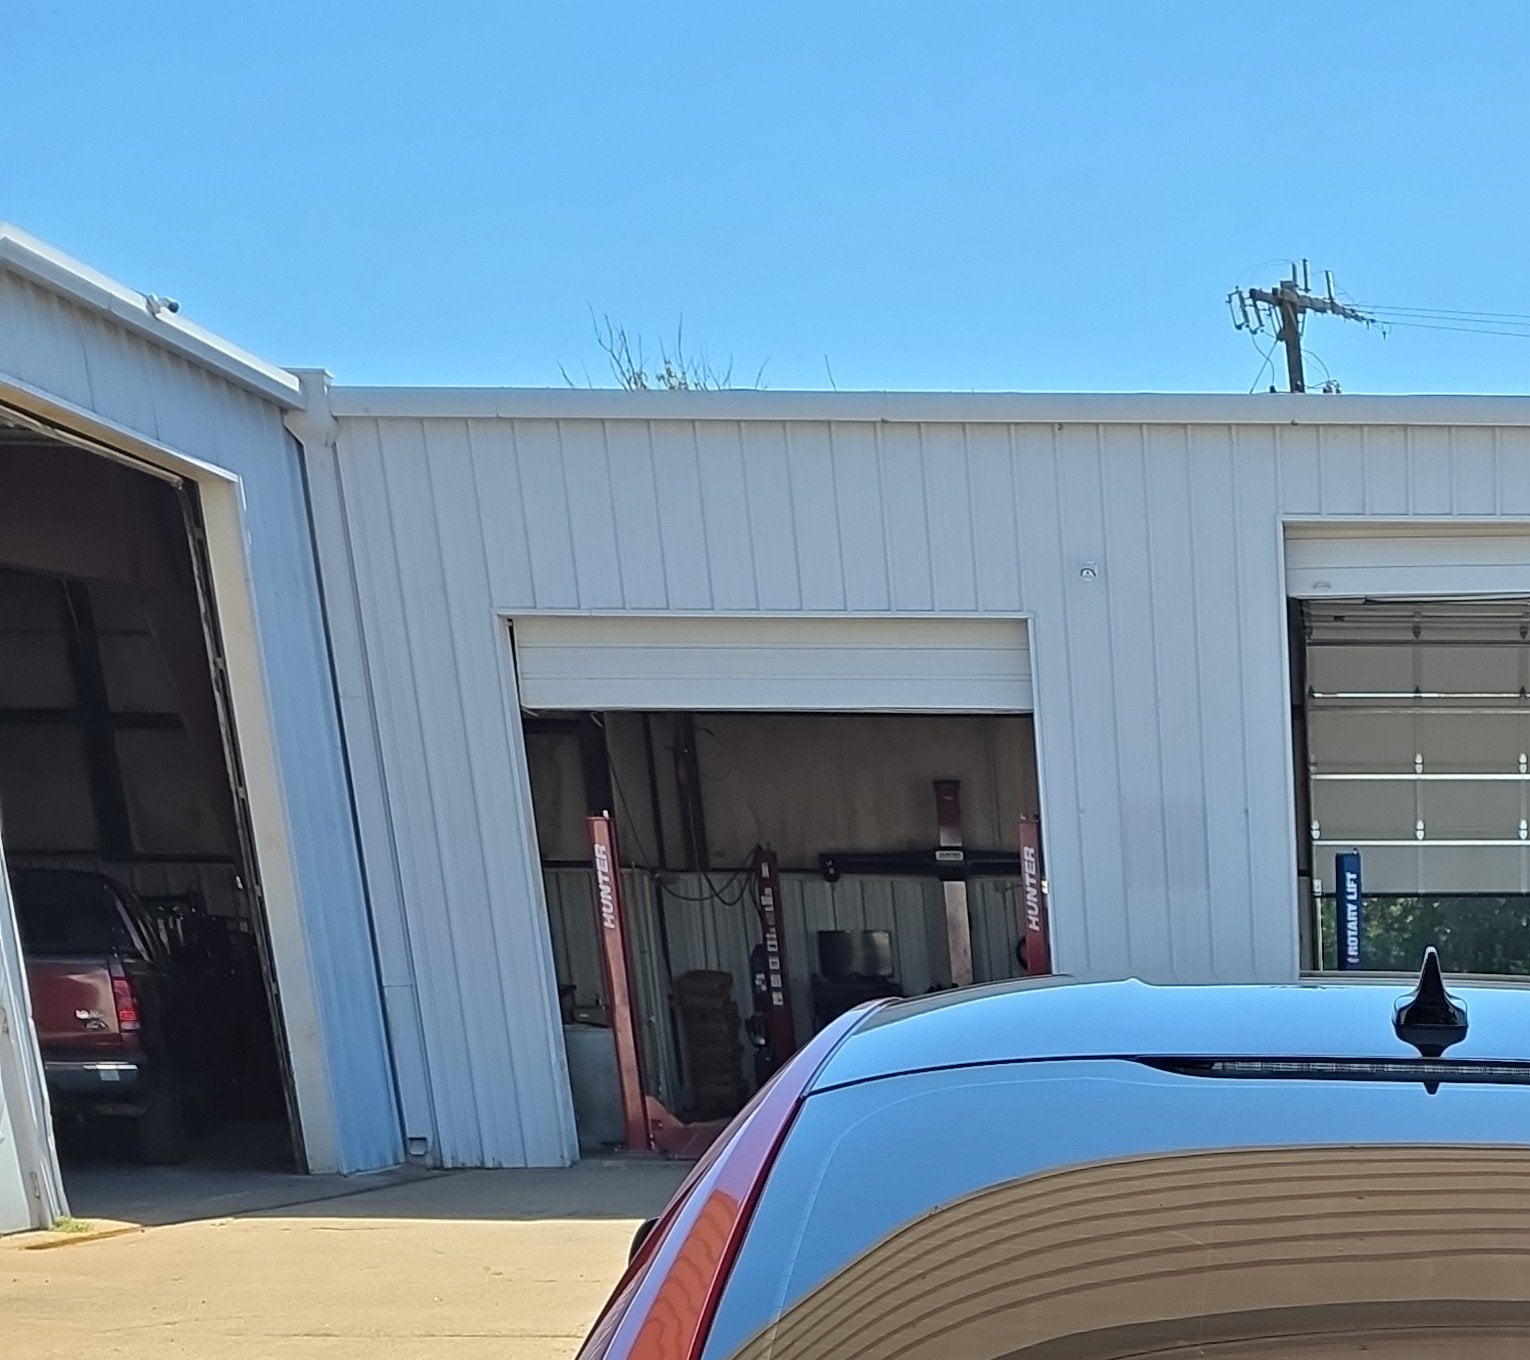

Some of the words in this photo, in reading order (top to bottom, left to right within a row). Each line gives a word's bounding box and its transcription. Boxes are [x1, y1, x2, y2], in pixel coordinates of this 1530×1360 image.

[594, 843, 615, 928] HUNTER
[1024, 846, 1040, 931] HUNTER
[1346, 872, 1358, 900] LIFT
[1347, 903, 1359, 956] ROTARY
